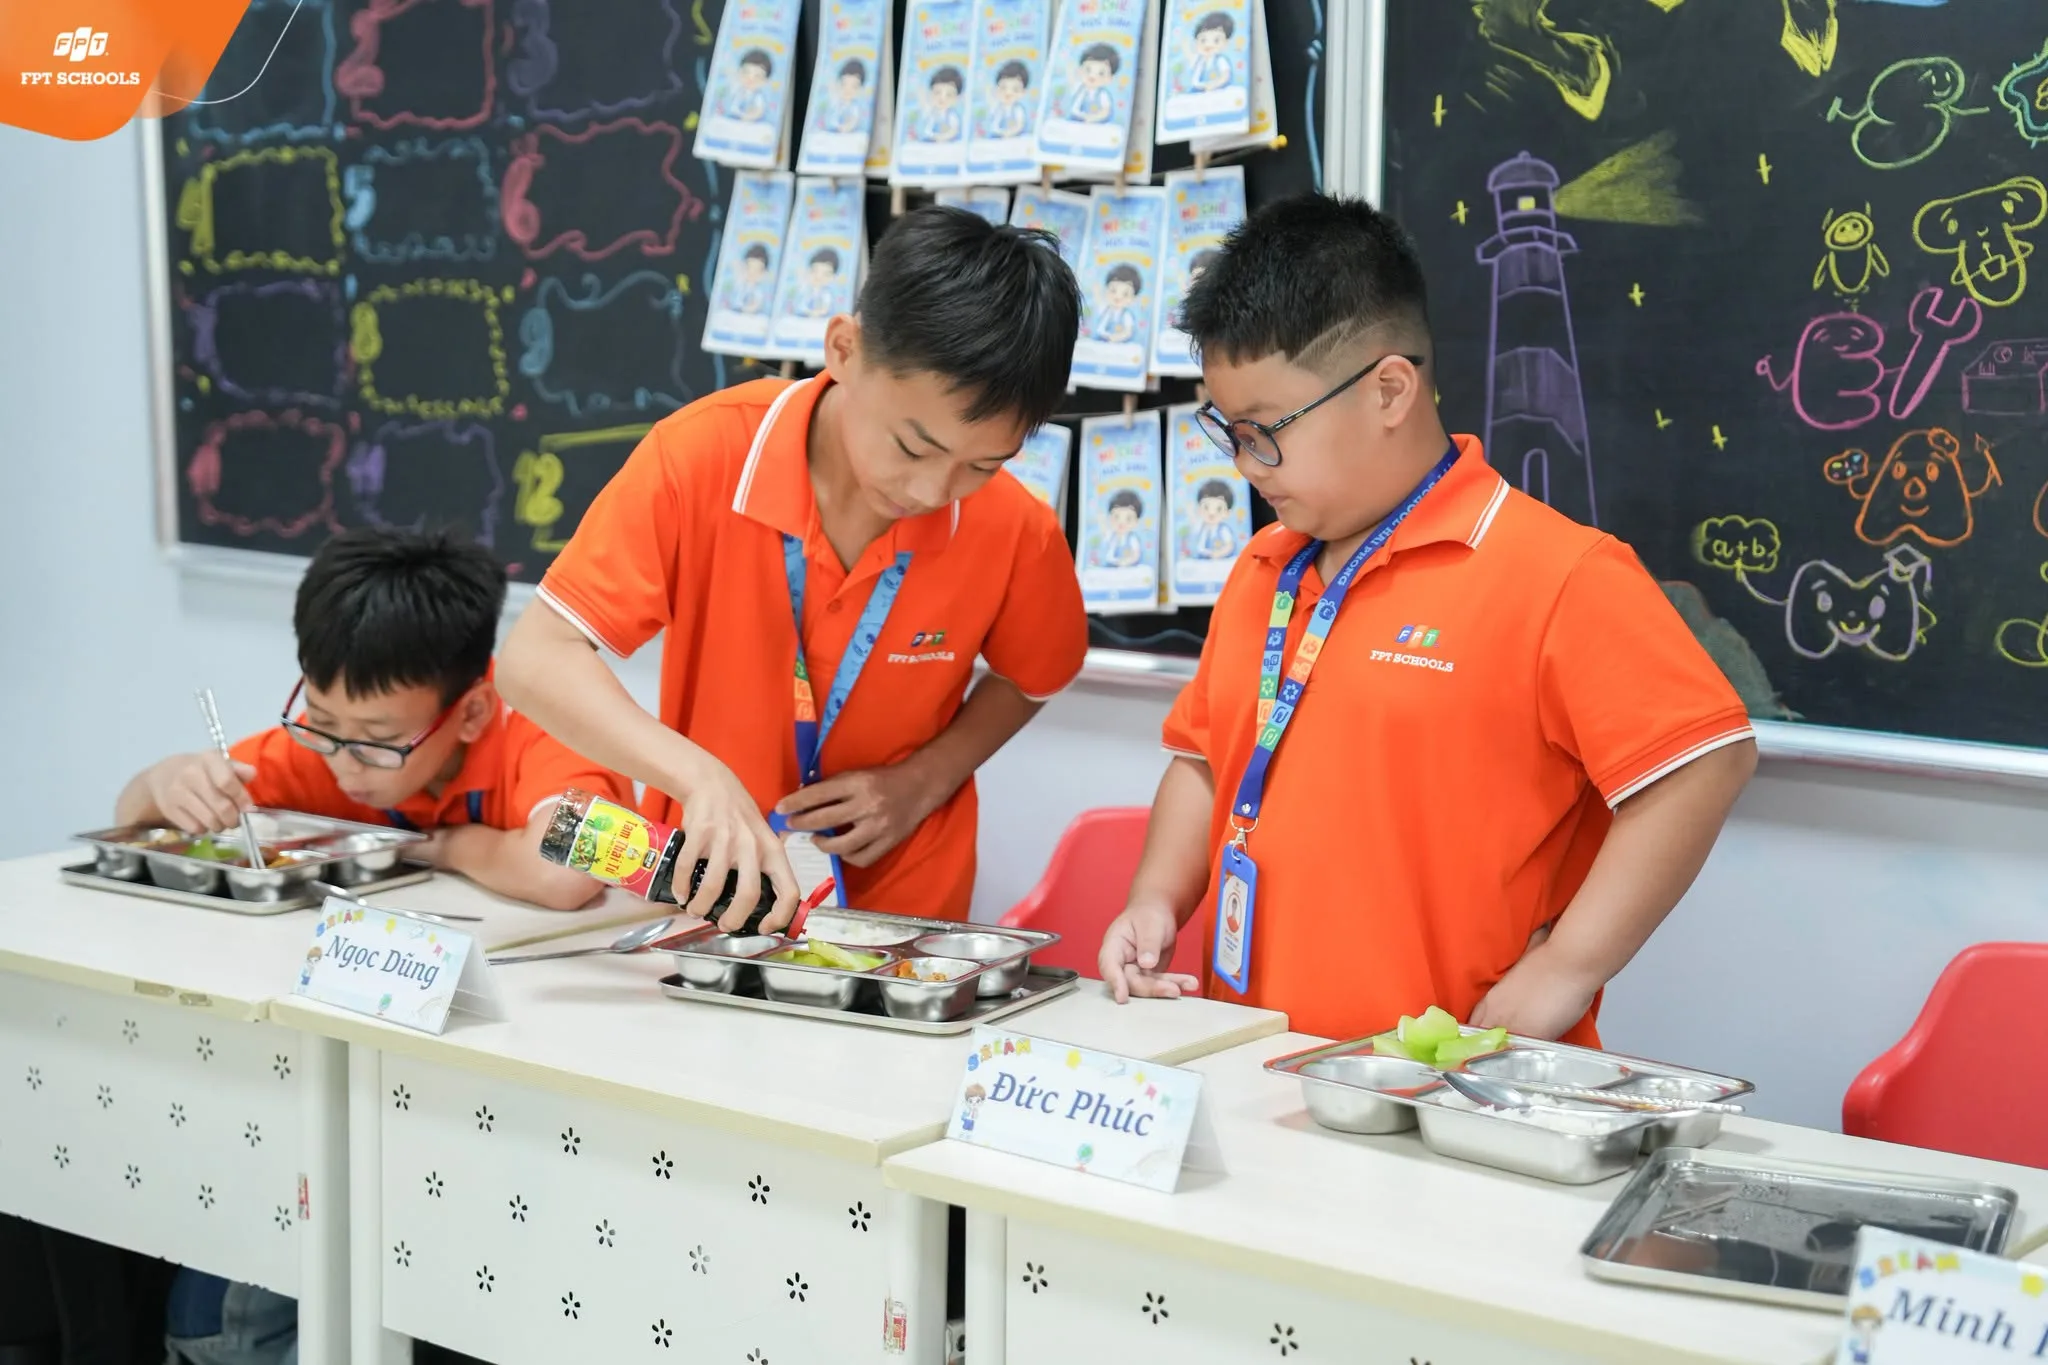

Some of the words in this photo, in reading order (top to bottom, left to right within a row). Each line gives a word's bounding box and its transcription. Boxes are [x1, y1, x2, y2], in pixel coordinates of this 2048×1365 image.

[1337, 546, 1373, 586] PHONG
[1396, 626, 1440, 647] FPT
[1369, 650, 1393, 662] FPT
[1393, 653, 1454, 672] SCHOOLS
[620, 820, 638, 838] Tam
[325, 935, 379, 972] Ngọc
[381, 949, 440, 990] Dũng
[988, 1072, 1059, 1114] Đức
[1065, 1089, 1153, 1136] Phúc
[1888, 1287, 2015, 1349] Minh
